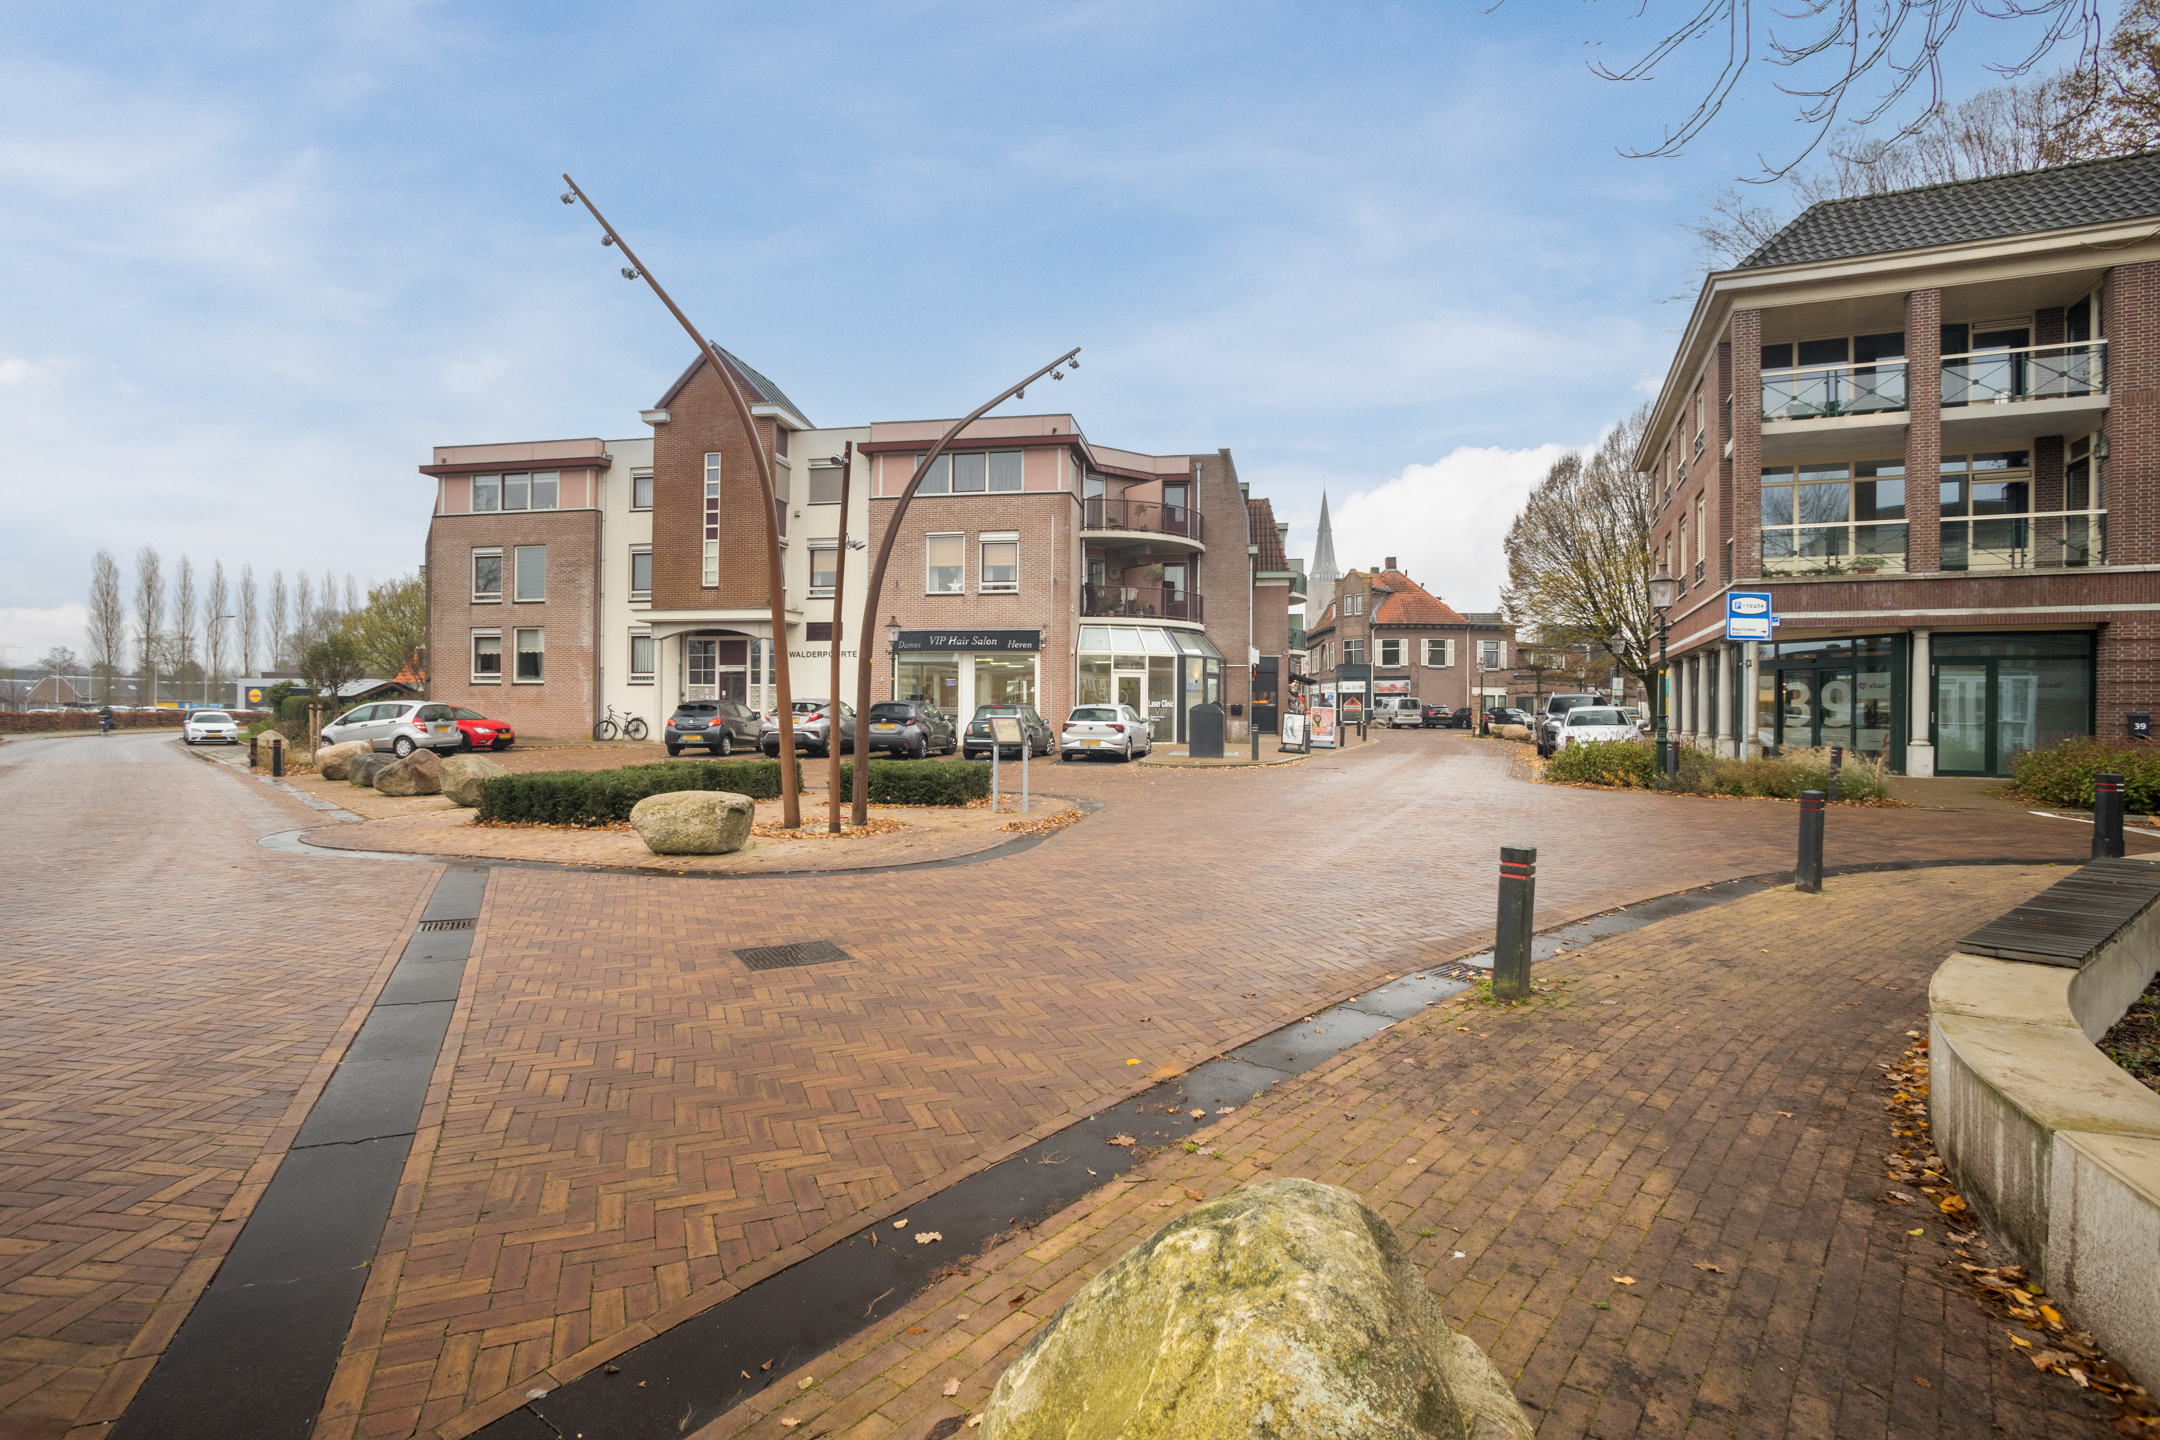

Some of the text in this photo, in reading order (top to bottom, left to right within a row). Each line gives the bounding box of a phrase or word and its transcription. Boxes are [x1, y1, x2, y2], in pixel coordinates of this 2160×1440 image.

[898, 636, 1033, 649] Dames VIP Hair Salon Heren
[1148, 699, 1174, 708] Laser Clinic
[2134, 722, 2147, 730] 39
